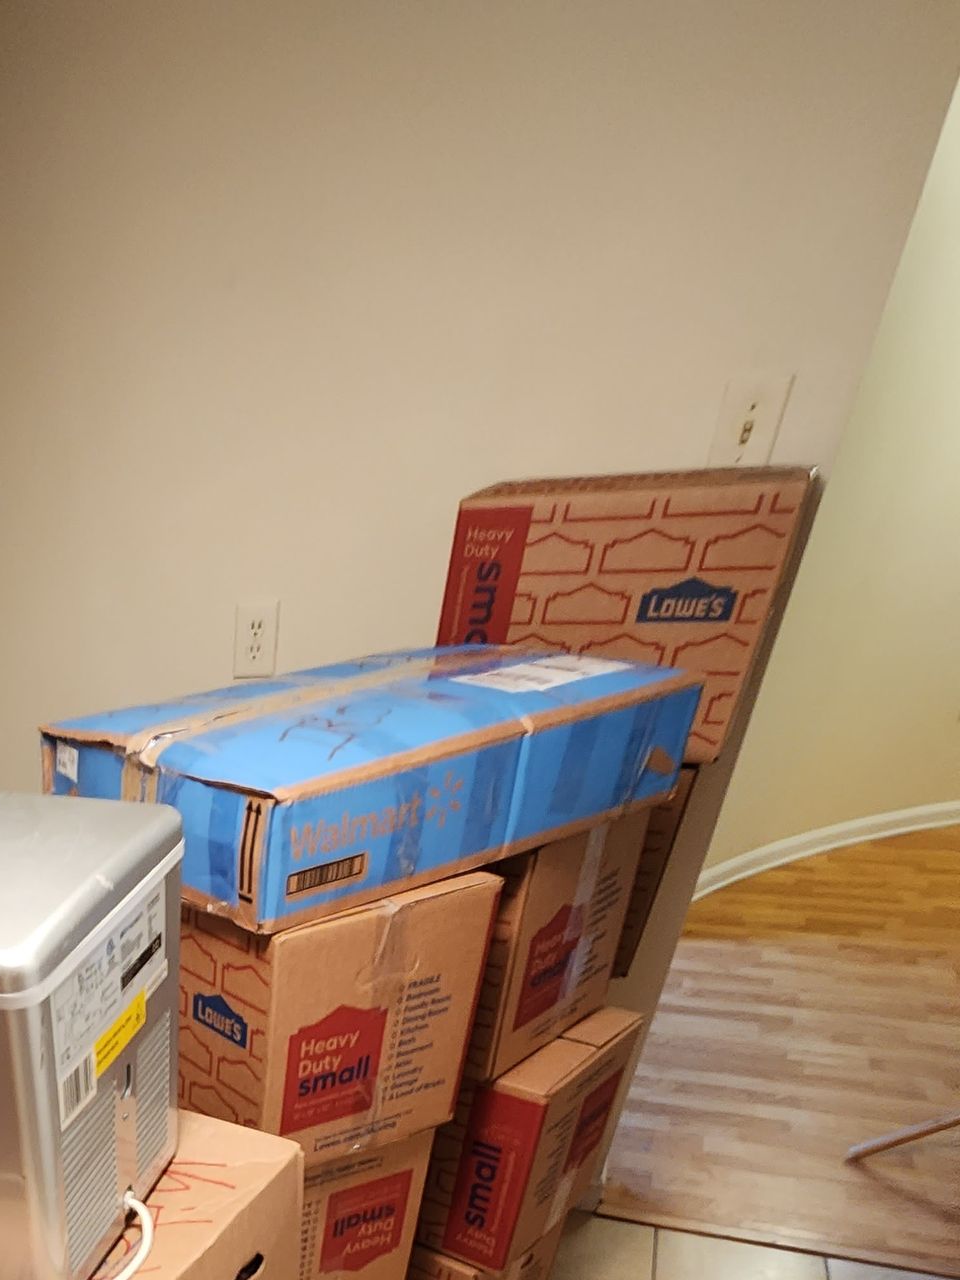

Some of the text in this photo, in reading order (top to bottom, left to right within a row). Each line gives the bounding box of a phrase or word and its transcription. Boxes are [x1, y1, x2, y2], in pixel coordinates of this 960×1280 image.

[466, 526, 515, 543] Heavy
[463, 543, 500, 559] Duty
[646, 592, 726, 618] LOWE'S
[290, 790, 422, 861] Walmart
[197, 1000, 242, 1041] LOWE'S
[300, 1030, 360, 1059] Heavy
[298, 1054, 342, 1079] Duty
[298, 1054, 371, 1097] small
[465, 1140, 502, 1229] small
[332, 1203, 396, 1238] small
